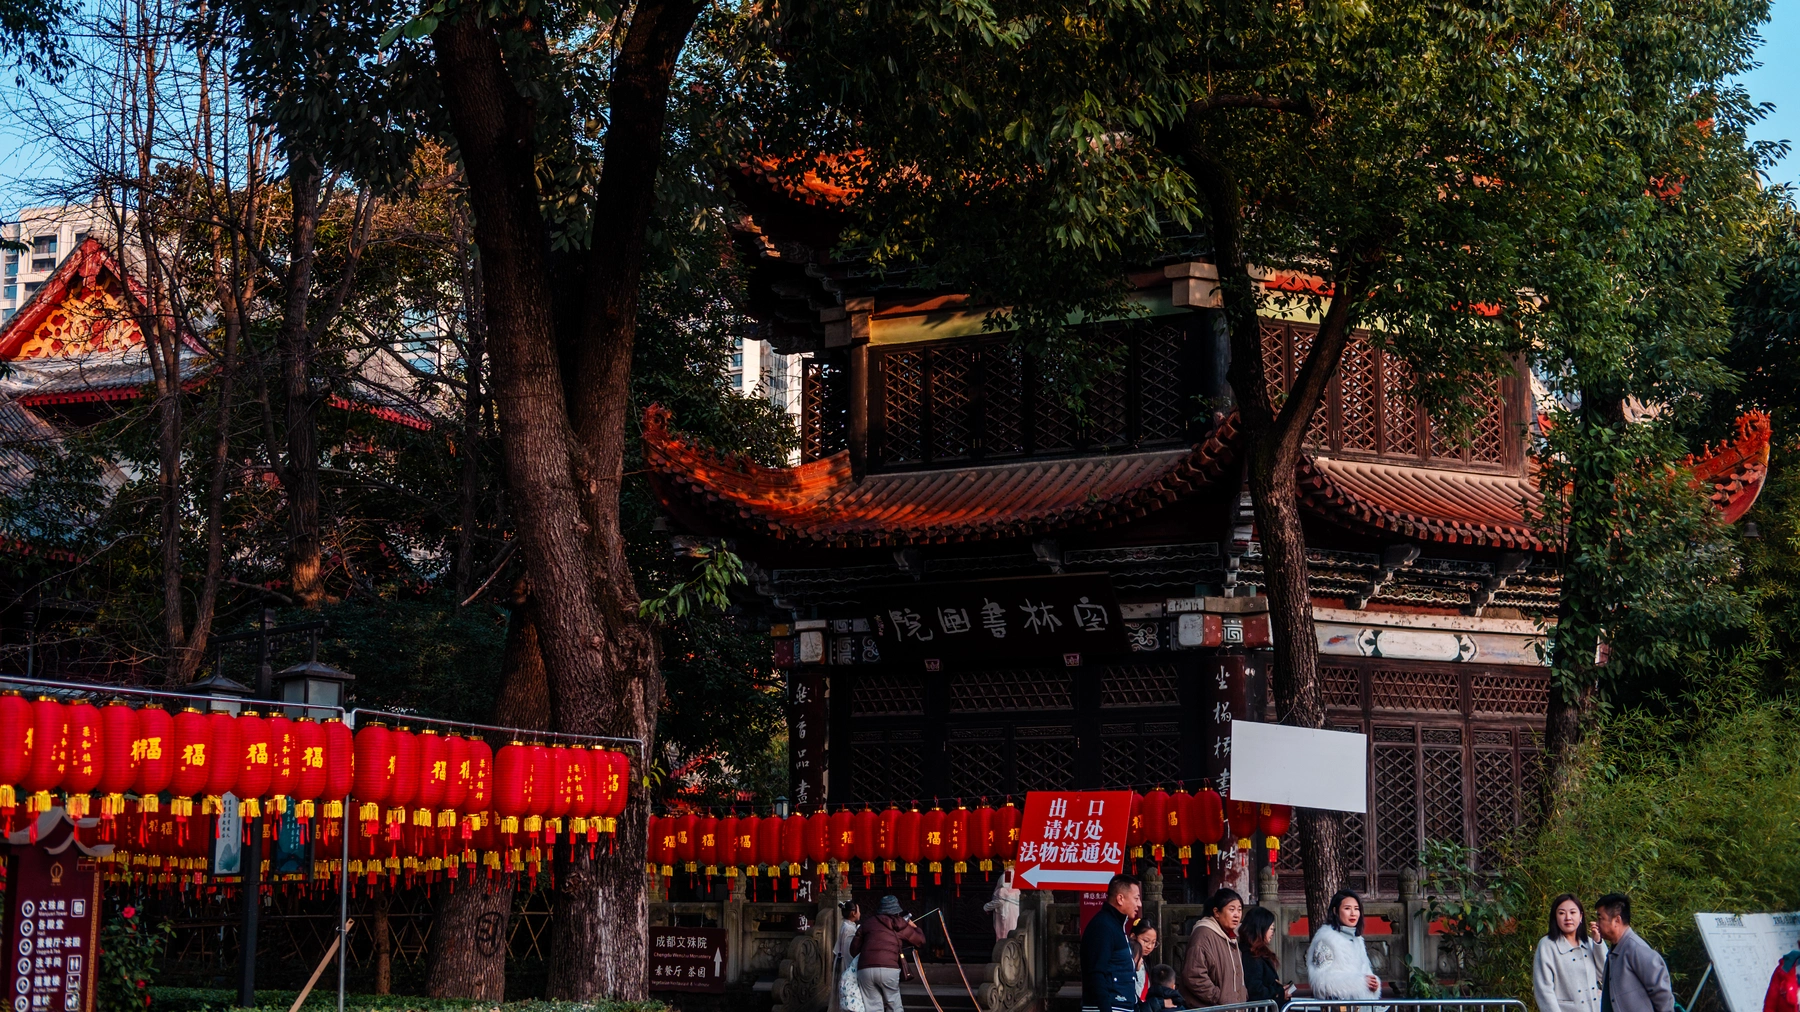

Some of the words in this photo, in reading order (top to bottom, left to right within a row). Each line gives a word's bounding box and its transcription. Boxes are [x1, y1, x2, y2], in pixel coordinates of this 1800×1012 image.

[181, 743, 205, 766] 福
[247, 742, 268, 764] 福
[302, 747, 323, 768] 福
[1048, 798, 1105, 818] 出口
[927, 831, 941, 846] 福
[1043, 820, 1104, 840] 请灯处
[663, 835, 676, 848] 福
[702, 834, 715, 847] 福
[1019, 841, 1122, 864] 法物流通处
[656, 935, 708, 949] 成都文殊院
[35, 957, 61, 968] 洗手间
[655, 965, 682, 977] 素餐厅
